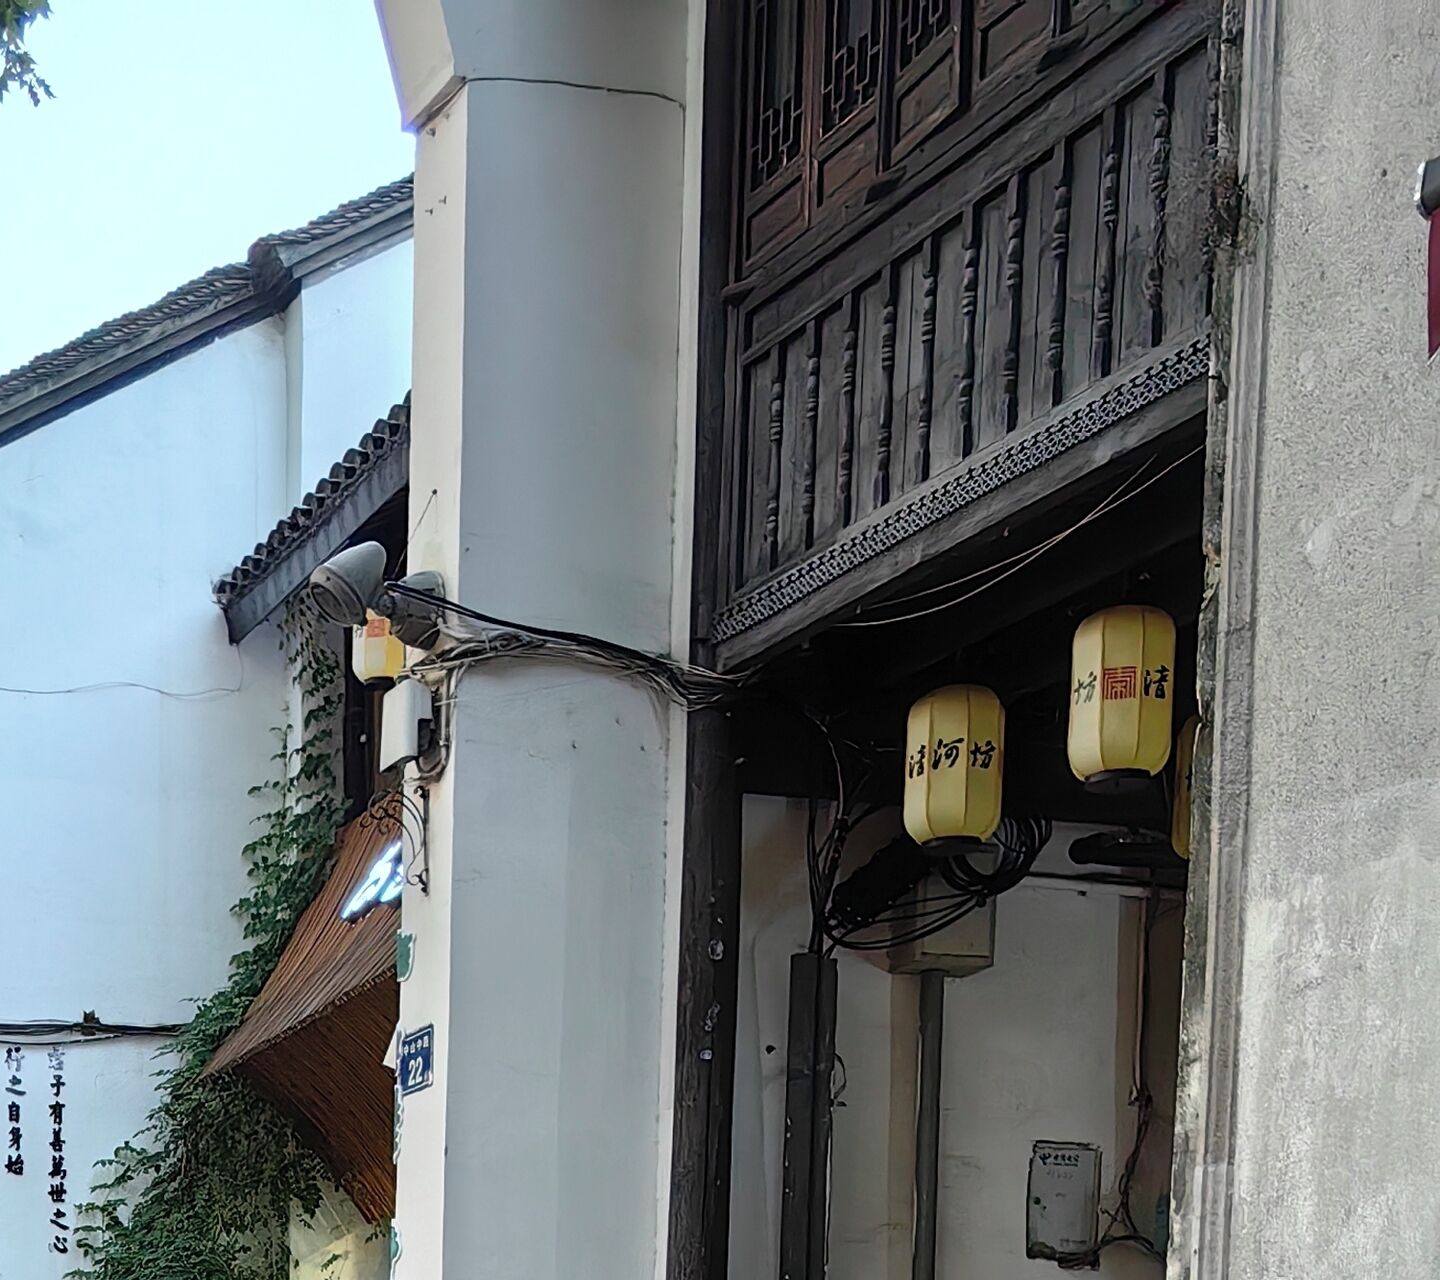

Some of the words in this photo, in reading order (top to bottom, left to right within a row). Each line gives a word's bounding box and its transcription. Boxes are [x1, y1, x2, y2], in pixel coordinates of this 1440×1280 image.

[908, 737, 997, 779] 清河坊
[407, 1056, 424, 1087] 22
[4, 1046, 27, 1176] 行之自身始
